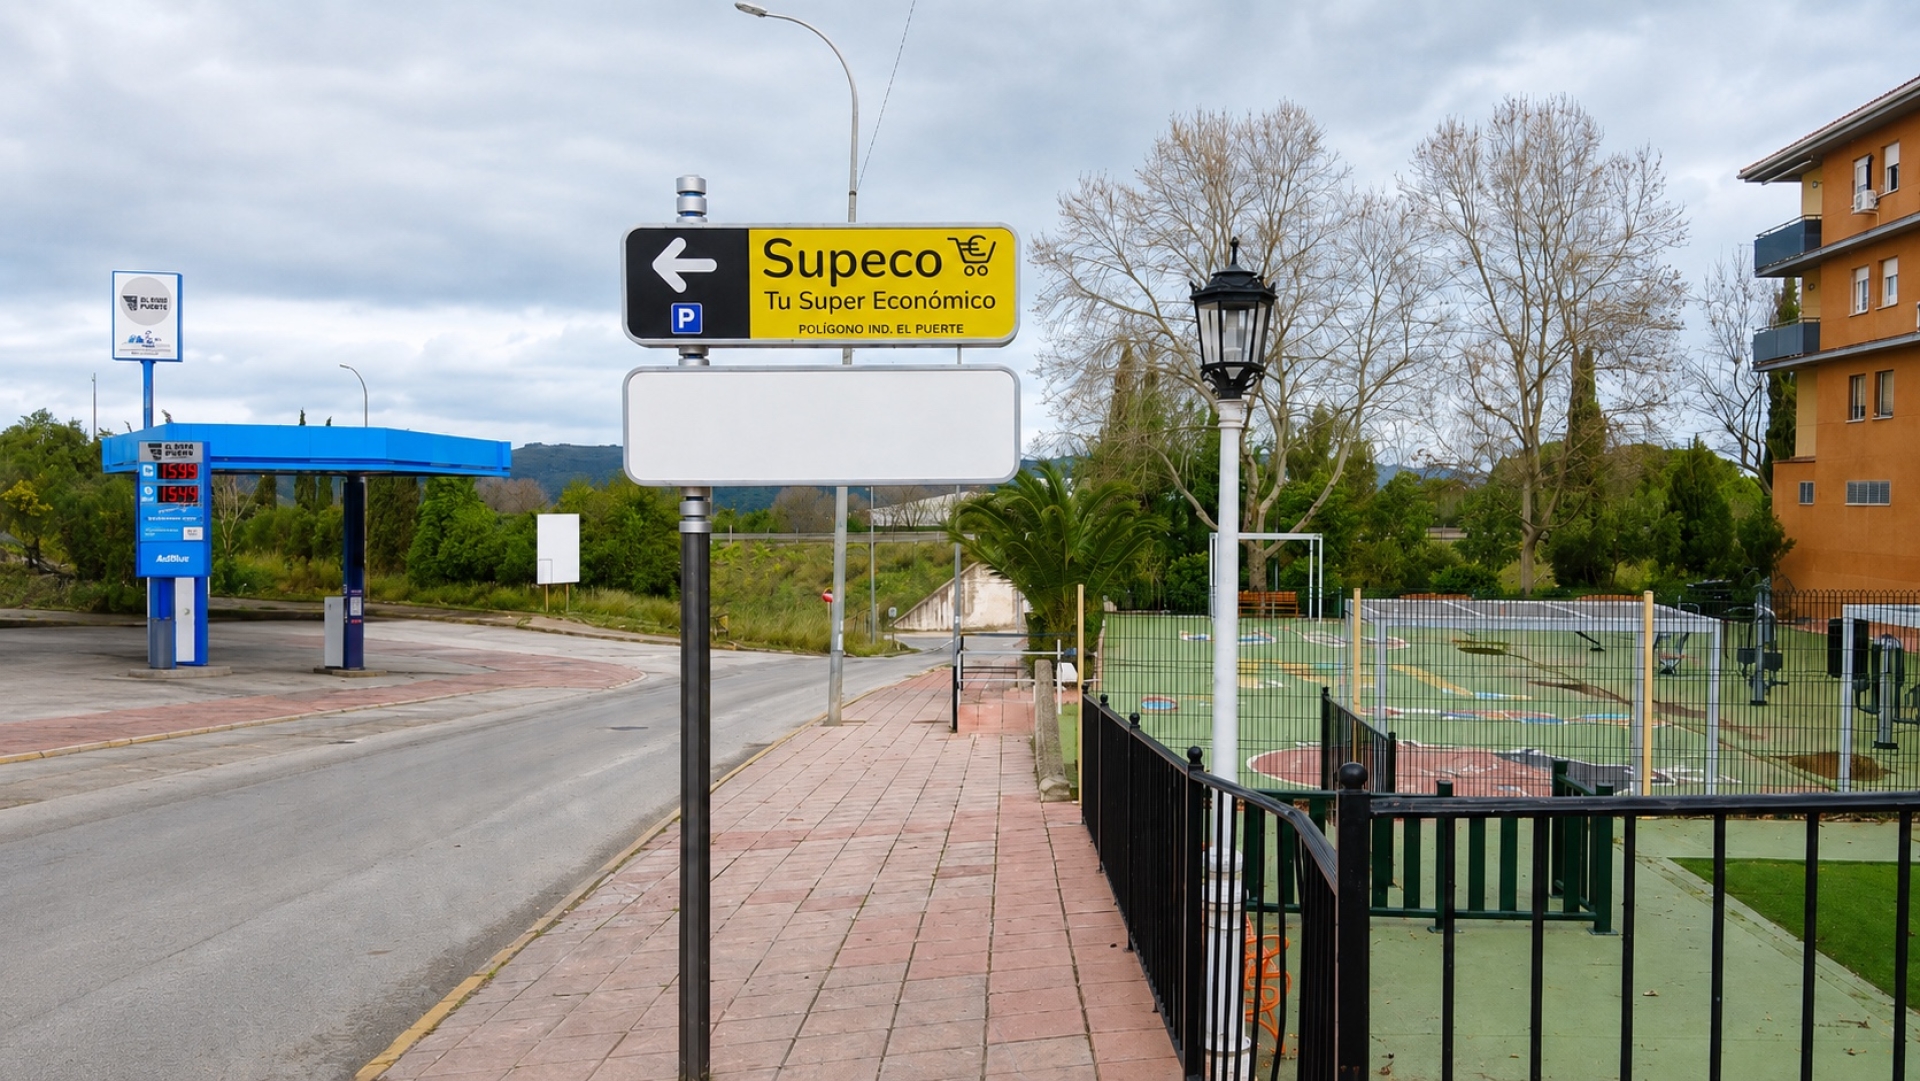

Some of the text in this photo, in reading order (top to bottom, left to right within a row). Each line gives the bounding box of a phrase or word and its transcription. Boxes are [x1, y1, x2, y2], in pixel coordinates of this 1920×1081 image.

[763, 237, 943, 288] Supeco
[763, 290, 996, 315] Tu Super Económico
[678, 308, 695, 328] P
[799, 323, 964, 334] POLÍGONO IND. EL PUERTE
